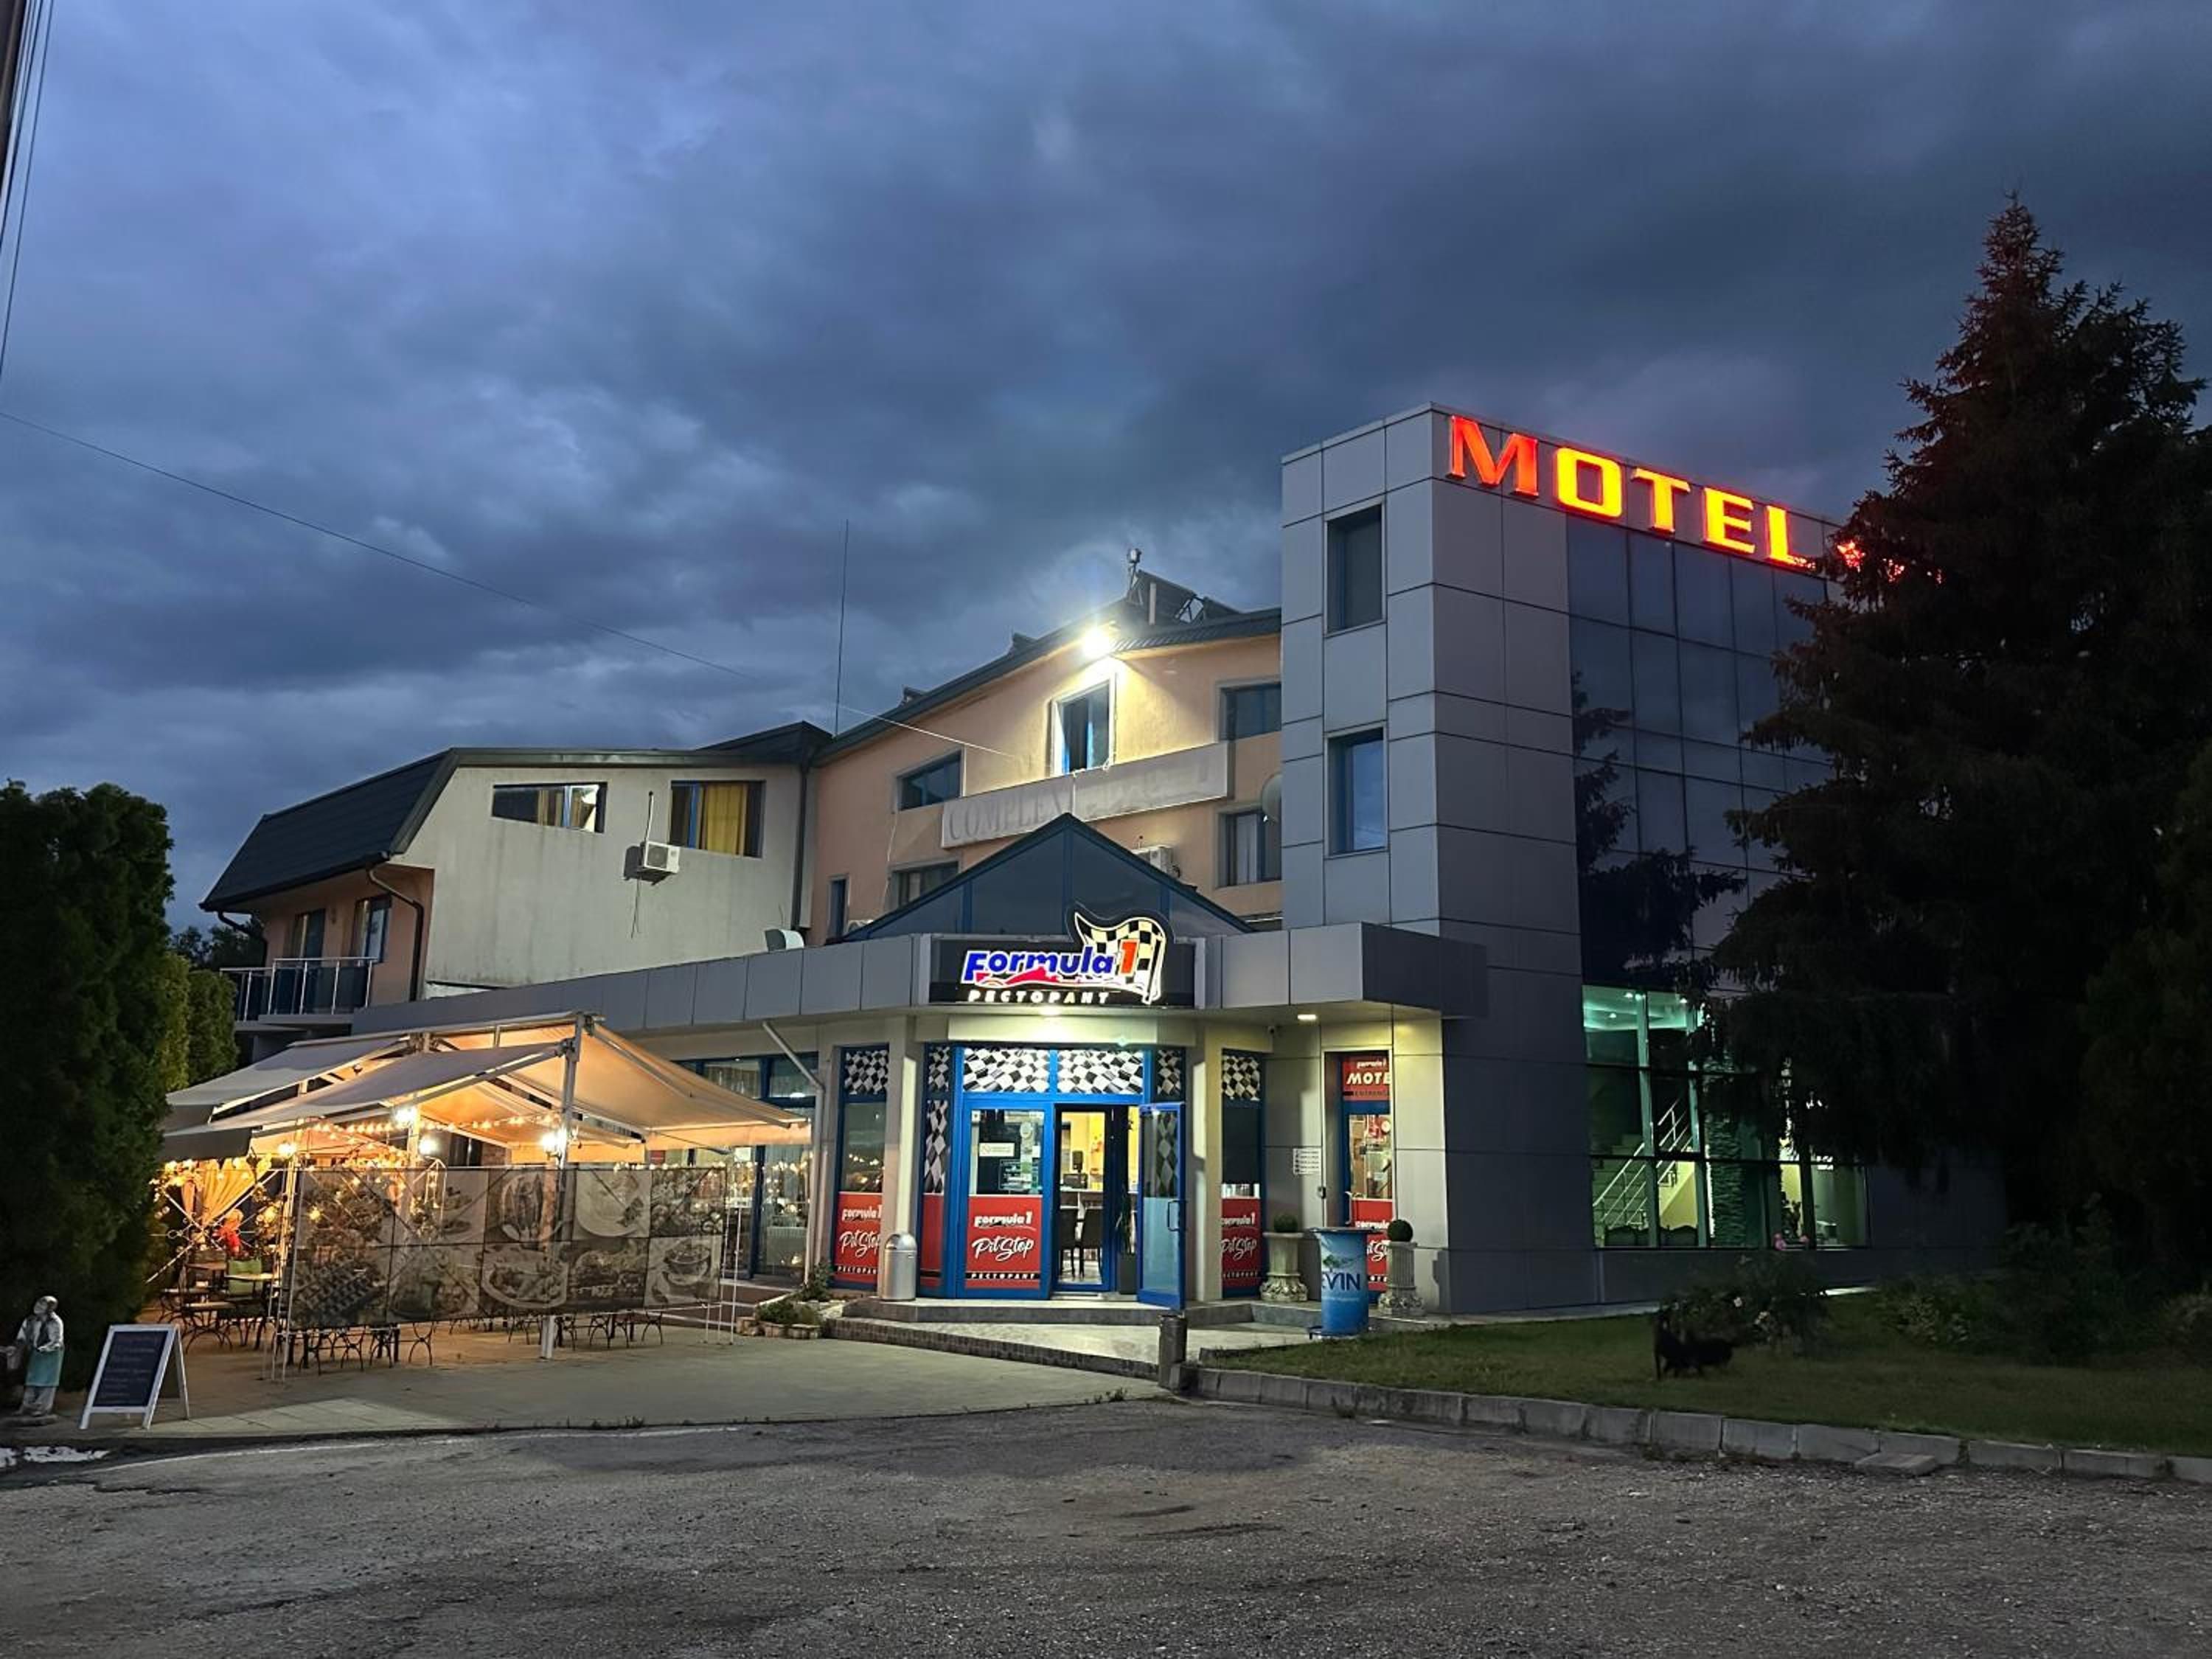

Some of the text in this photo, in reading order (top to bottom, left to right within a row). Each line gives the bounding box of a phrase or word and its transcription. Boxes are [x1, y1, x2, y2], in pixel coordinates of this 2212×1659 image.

[1448, 414, 1817, 569] MOTEL
[961, 944, 1115, 984] Formula
[1346, 1072, 1391, 1085] MOTE
